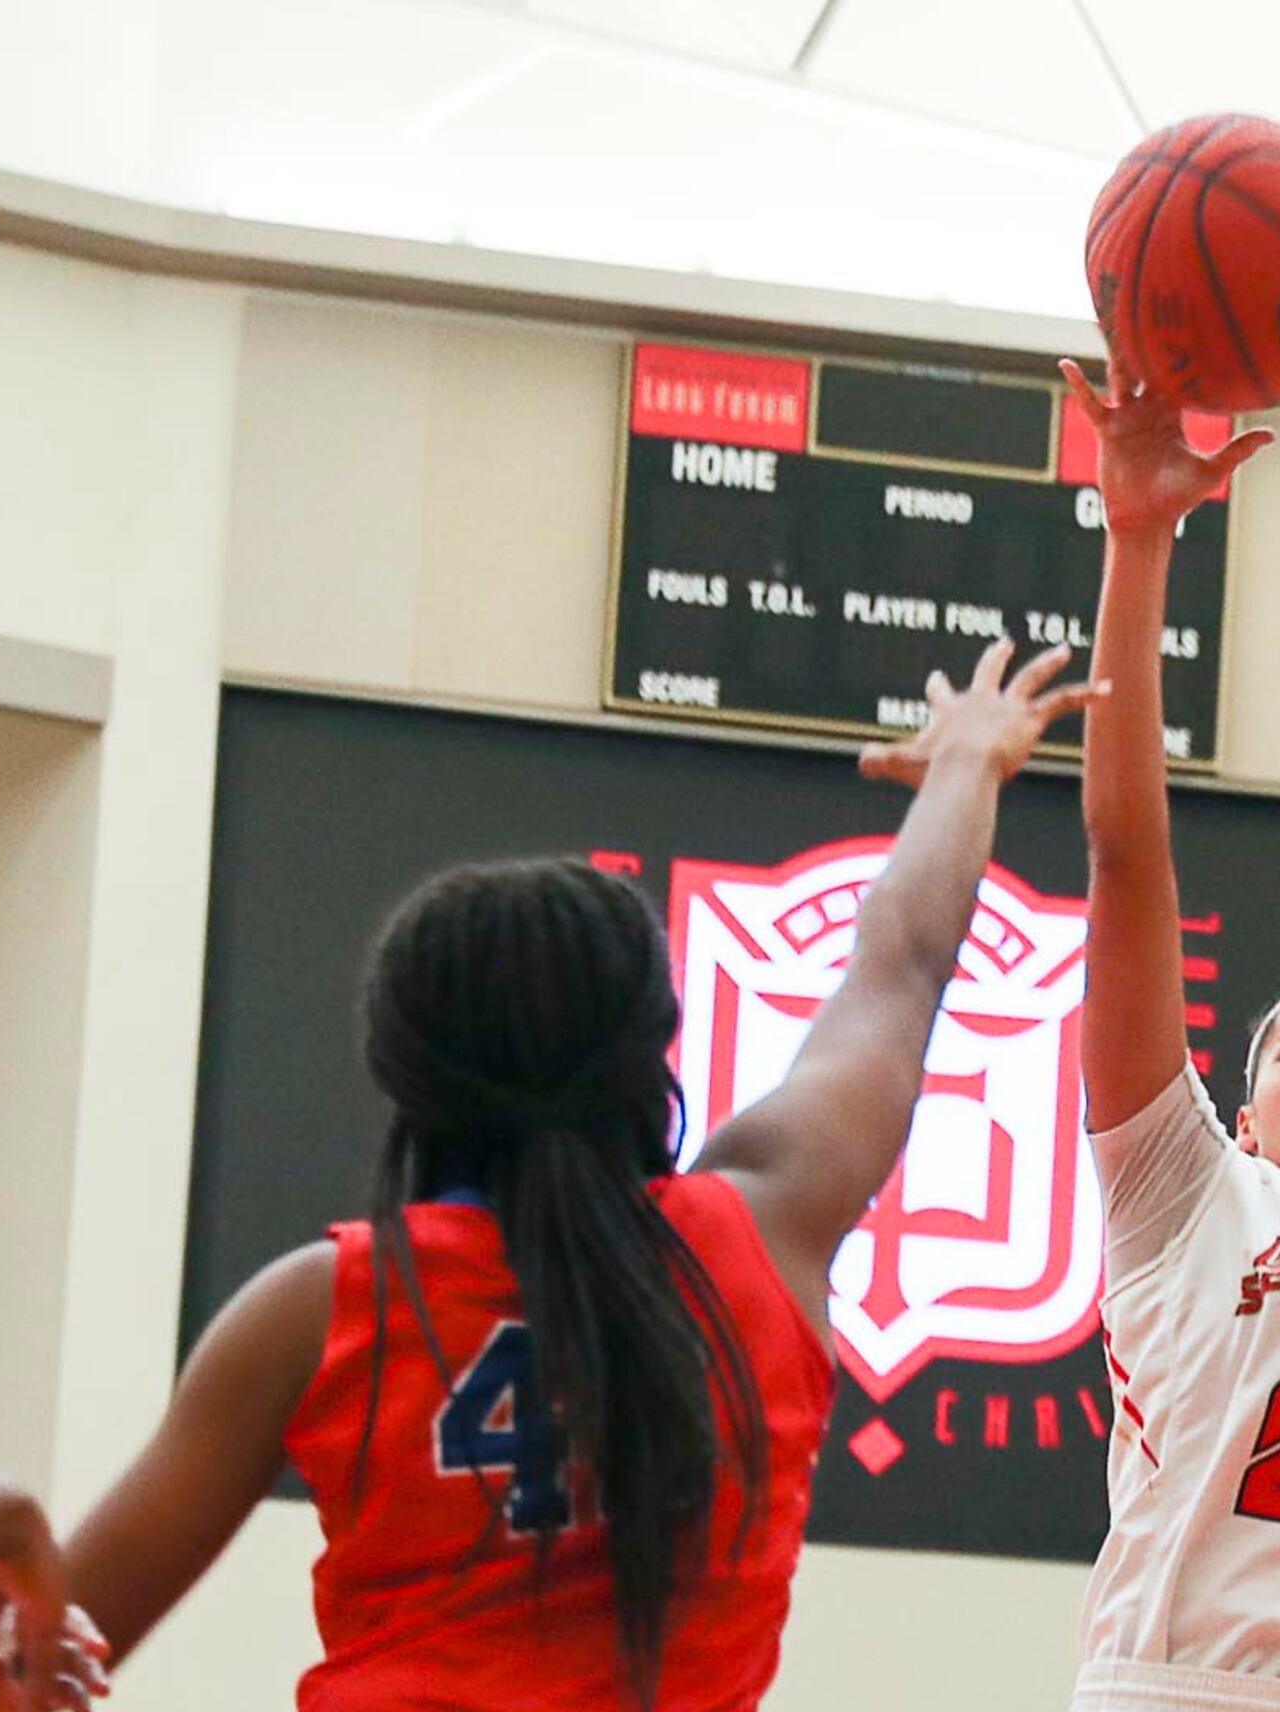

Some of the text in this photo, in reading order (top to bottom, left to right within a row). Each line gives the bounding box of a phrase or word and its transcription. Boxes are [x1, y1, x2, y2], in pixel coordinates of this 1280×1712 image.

[672, 441, 777, 491] HOME
[885, 485, 973, 524] PERIOD
[648, 569, 728, 606] FOULS
[843, 591, 937, 631] PLAYER
[639, 670, 719, 707] SCORE
